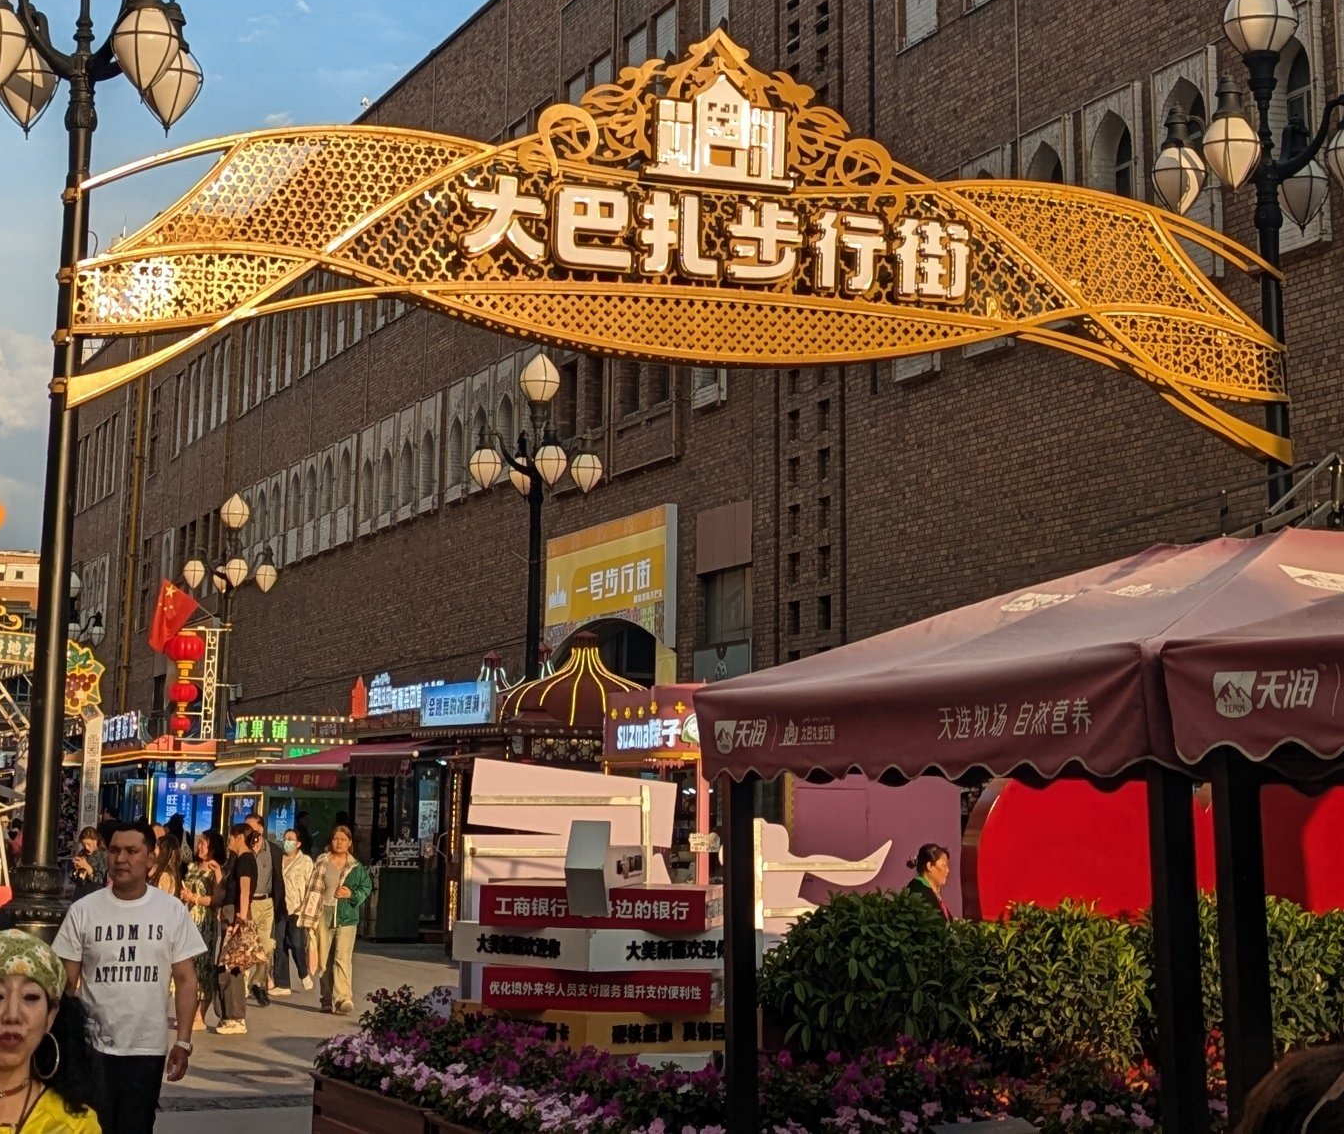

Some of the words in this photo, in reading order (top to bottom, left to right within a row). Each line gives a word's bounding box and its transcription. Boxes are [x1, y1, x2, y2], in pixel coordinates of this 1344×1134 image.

[462, 175, 970, 304] 大巴扎步行街
[1256, 667, 1319, 709] 天润
[937, 703, 1008, 741] 天选牧场
[1012, 696, 1093, 736] 自然营养
[734, 718, 768, 748] 天润
[493, 896, 568, 918] 工商银行
[606, 898, 690, 921] 边的银行
[147, 924, 164, 941] IS
[118, 946, 137, 962] AN
[94, 965, 159, 983] ATTITUDE
[488, 981, 622, 999] 优化境外来华人员支付服务
[623, 982, 702, 1001] 提升支付便利性
